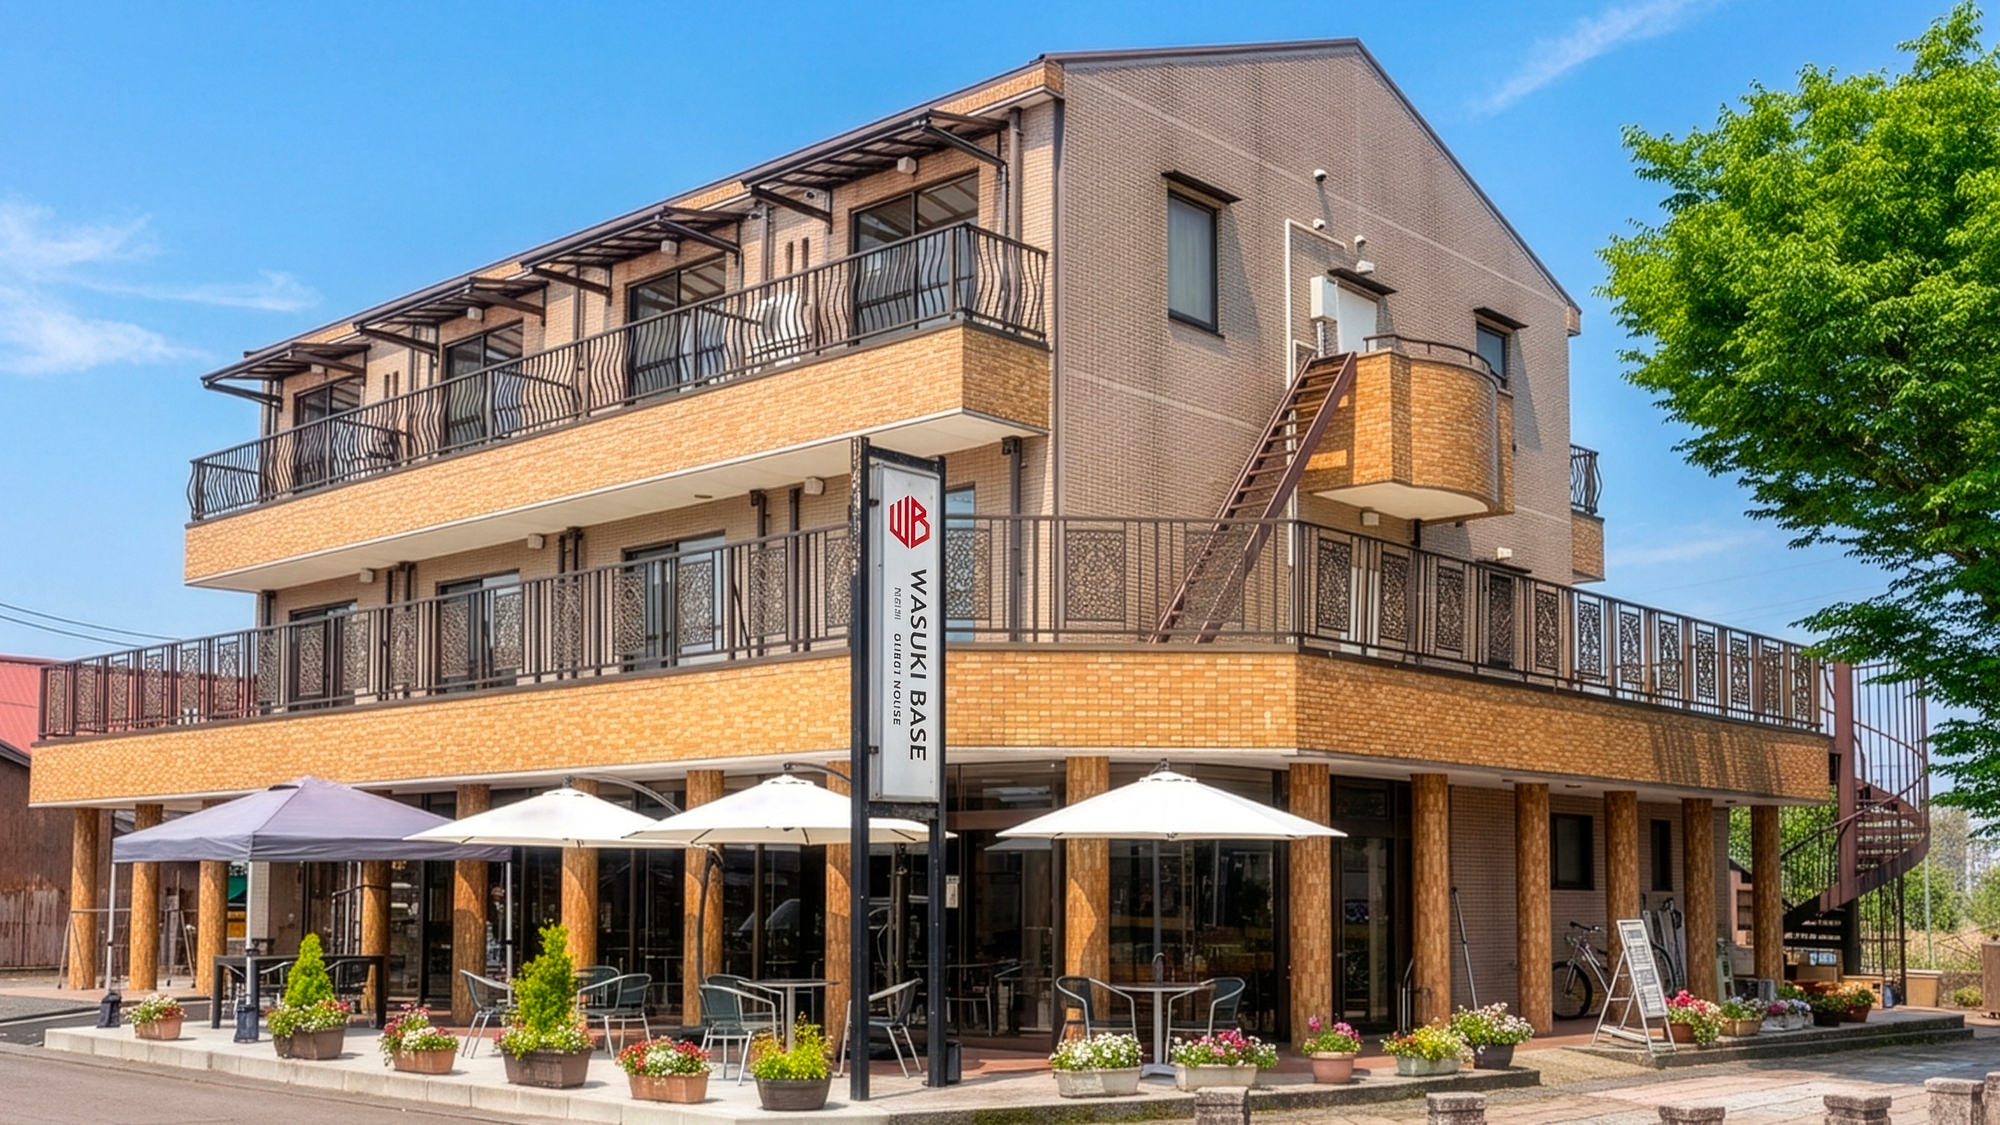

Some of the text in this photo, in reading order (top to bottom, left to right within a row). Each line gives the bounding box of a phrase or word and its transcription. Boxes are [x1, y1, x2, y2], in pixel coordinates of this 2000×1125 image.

[889, 495, 930, 549] WB
[910, 568, 928, 761] WASUKI BASE
